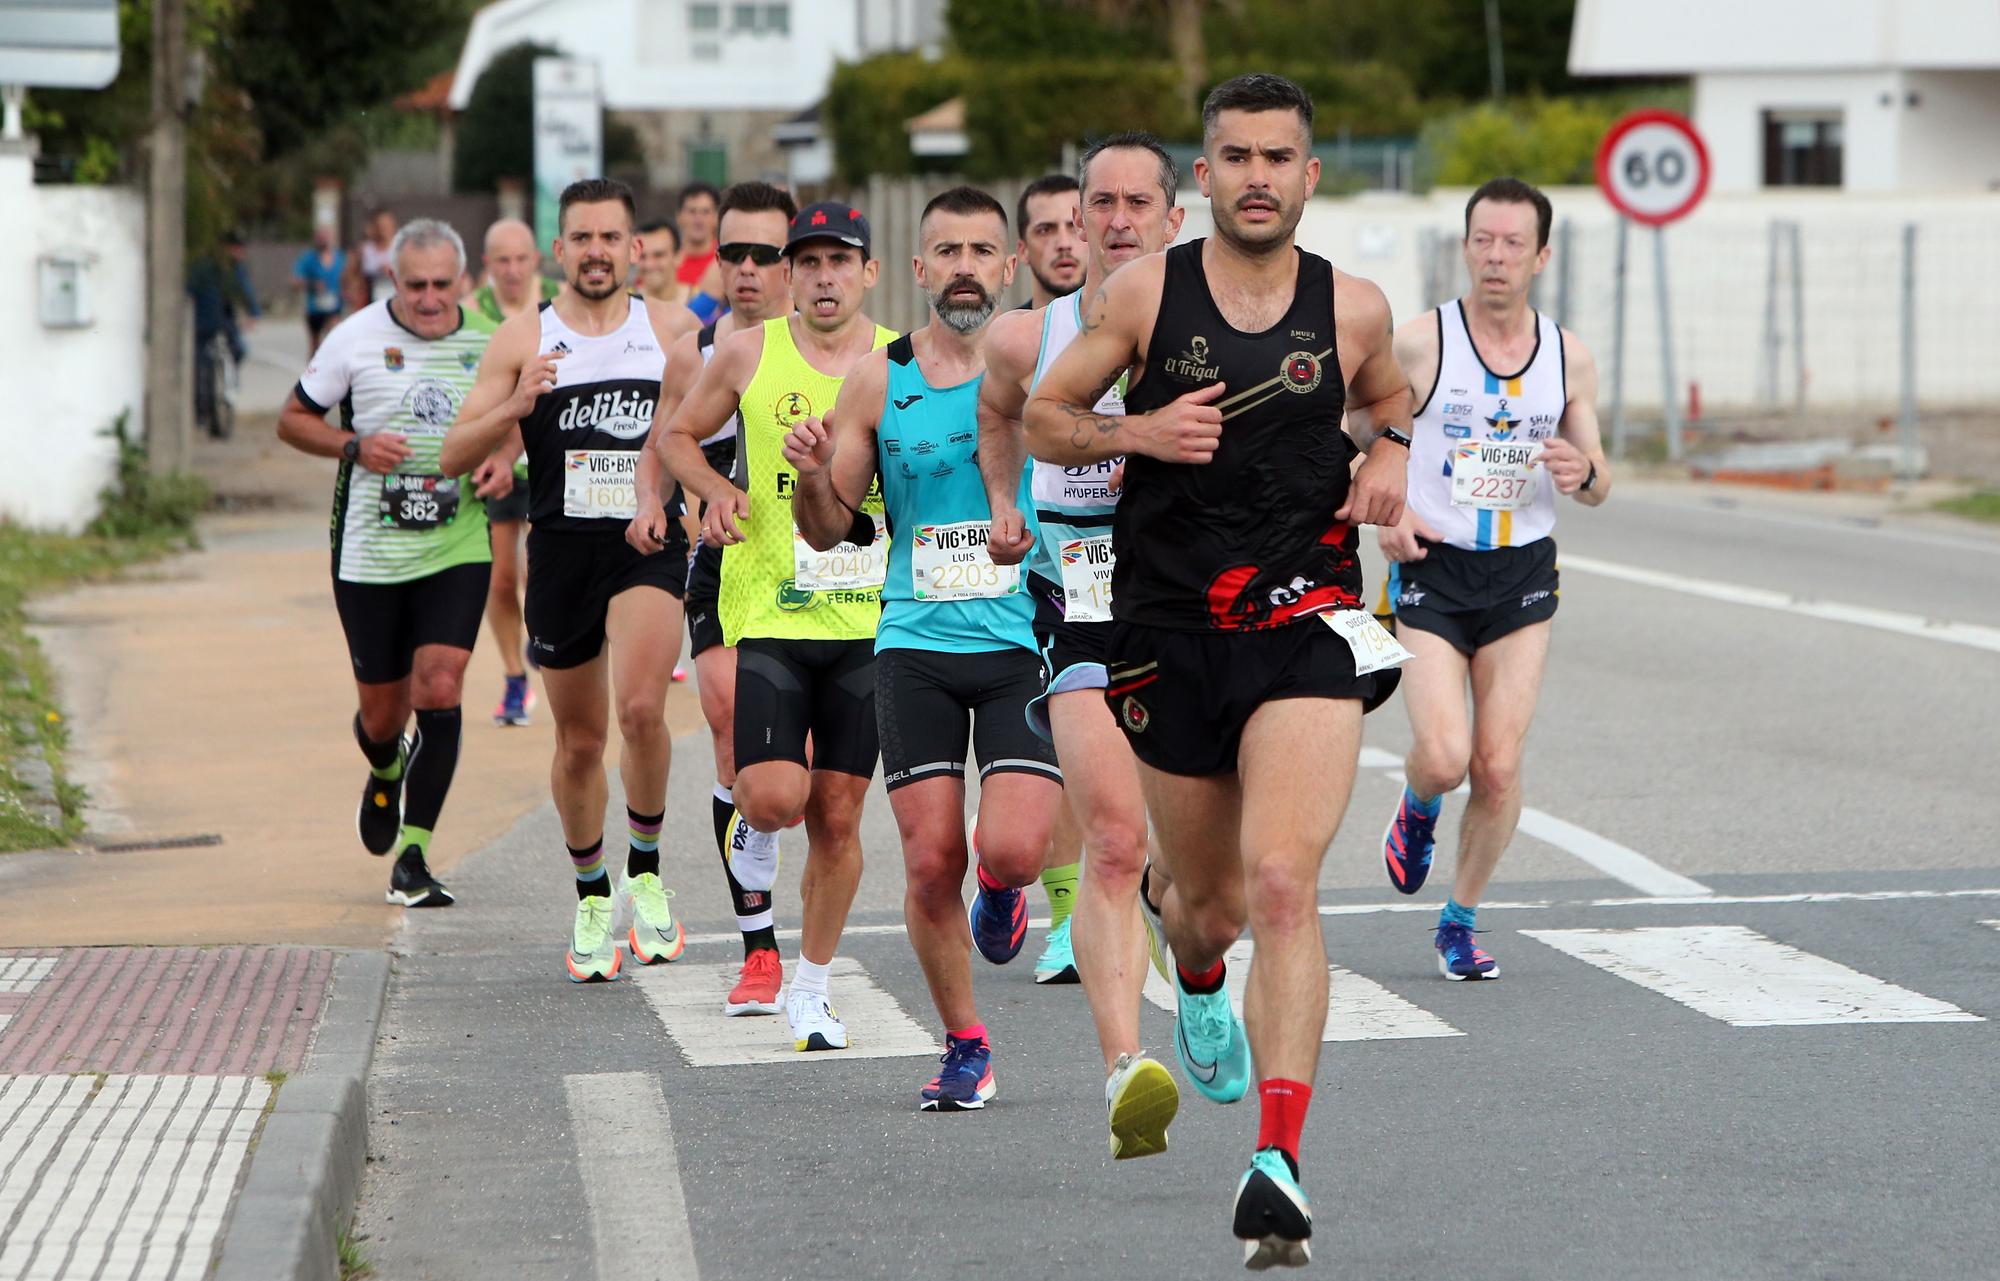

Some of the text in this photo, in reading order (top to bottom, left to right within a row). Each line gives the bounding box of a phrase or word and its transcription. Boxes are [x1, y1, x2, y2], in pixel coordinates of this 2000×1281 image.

[1624, 148, 1685, 189] 60
[1165, 358, 1176, 372] El
[1178, 360, 1219, 381] Trigal
[558, 390, 654, 431] delikia
[612, 420, 638, 431] fresh
[1487, 468, 1517, 477] SANDE
[1471, 477, 1527, 499] 2237
[400, 501, 439, 521] 362
[952, 553, 975, 562] LUIS
[1085, 544, 1108, 564] VIG
[816, 553, 872, 578] 2040
[931, 563, 999, 589] 2203
[1346, 614, 1367, 628] DIEGO
